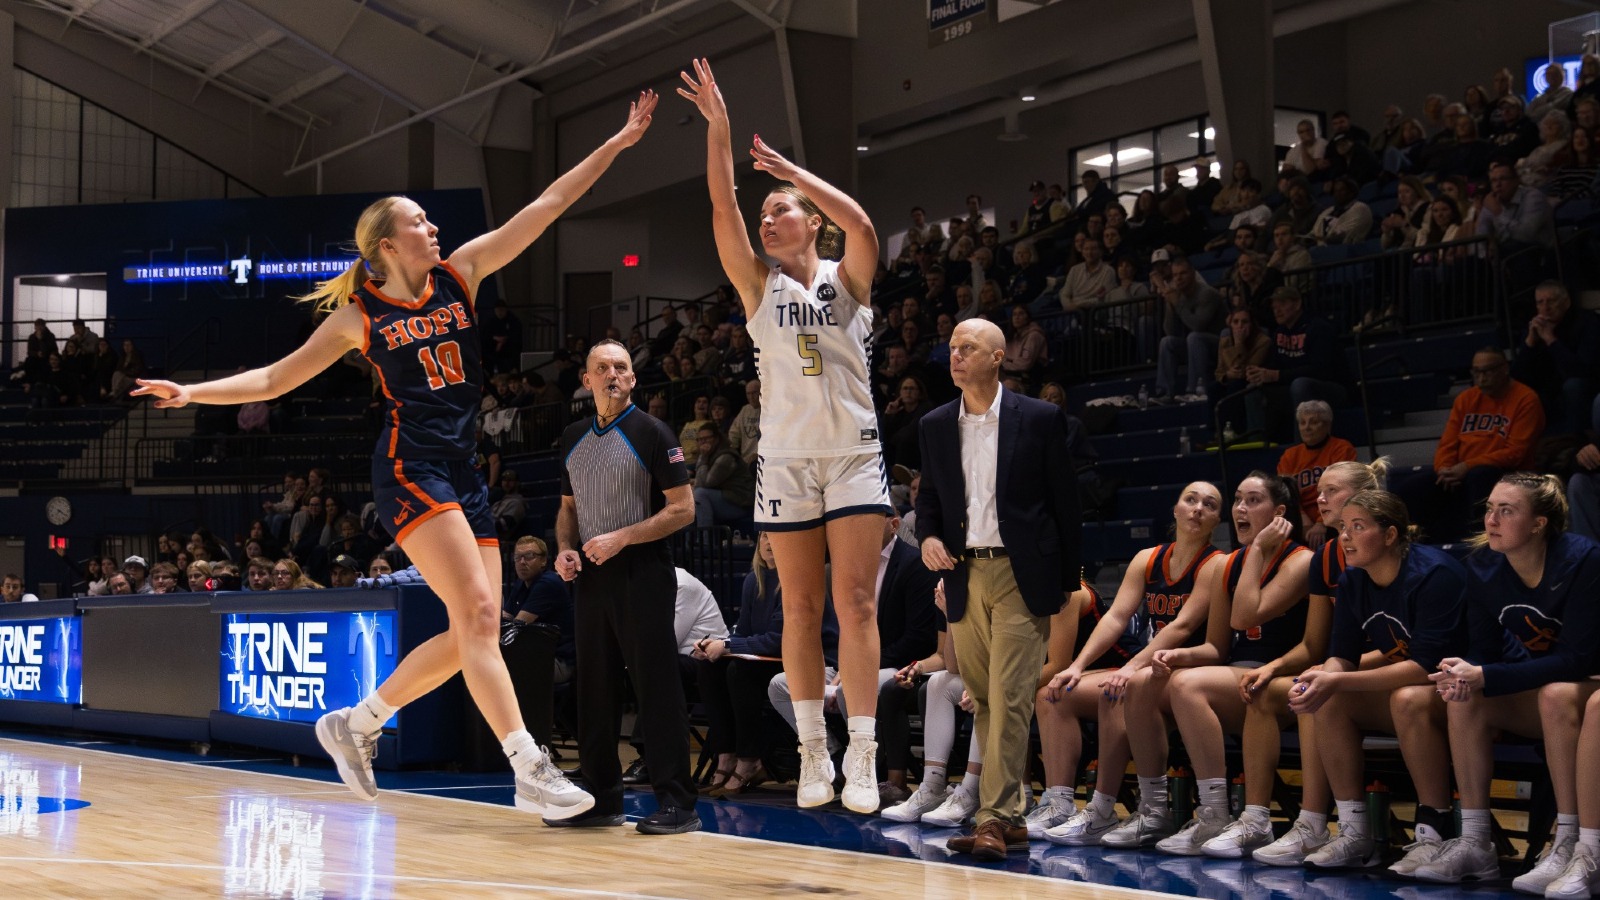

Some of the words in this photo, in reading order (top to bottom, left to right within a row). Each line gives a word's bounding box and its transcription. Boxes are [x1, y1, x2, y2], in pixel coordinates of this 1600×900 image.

[931, 2, 958, 22] FINAL
[943, 20, 972, 41] 1999
[137, 268, 164, 278] TRINE
[168, 266, 223, 277] UNIVERSITY
[231, 258, 252, 284] T
[260, 263, 284, 274] HOME
[287, 263, 298, 272] OF
[301, 262, 318, 272] THE
[321, 261, 354, 271] THUND
[379, 302, 472, 351] HOPE
[776, 302, 838, 327] TRINE
[418, 340, 466, 391] 10
[797, 334, 822, 376] 5
[768, 499, 782, 517] T
[0, 625, 45, 664] RINE
[228, 622, 328, 674] TRINE
[0, 665, 41, 691] UNDER
[227, 673, 327, 710] THUNDER
